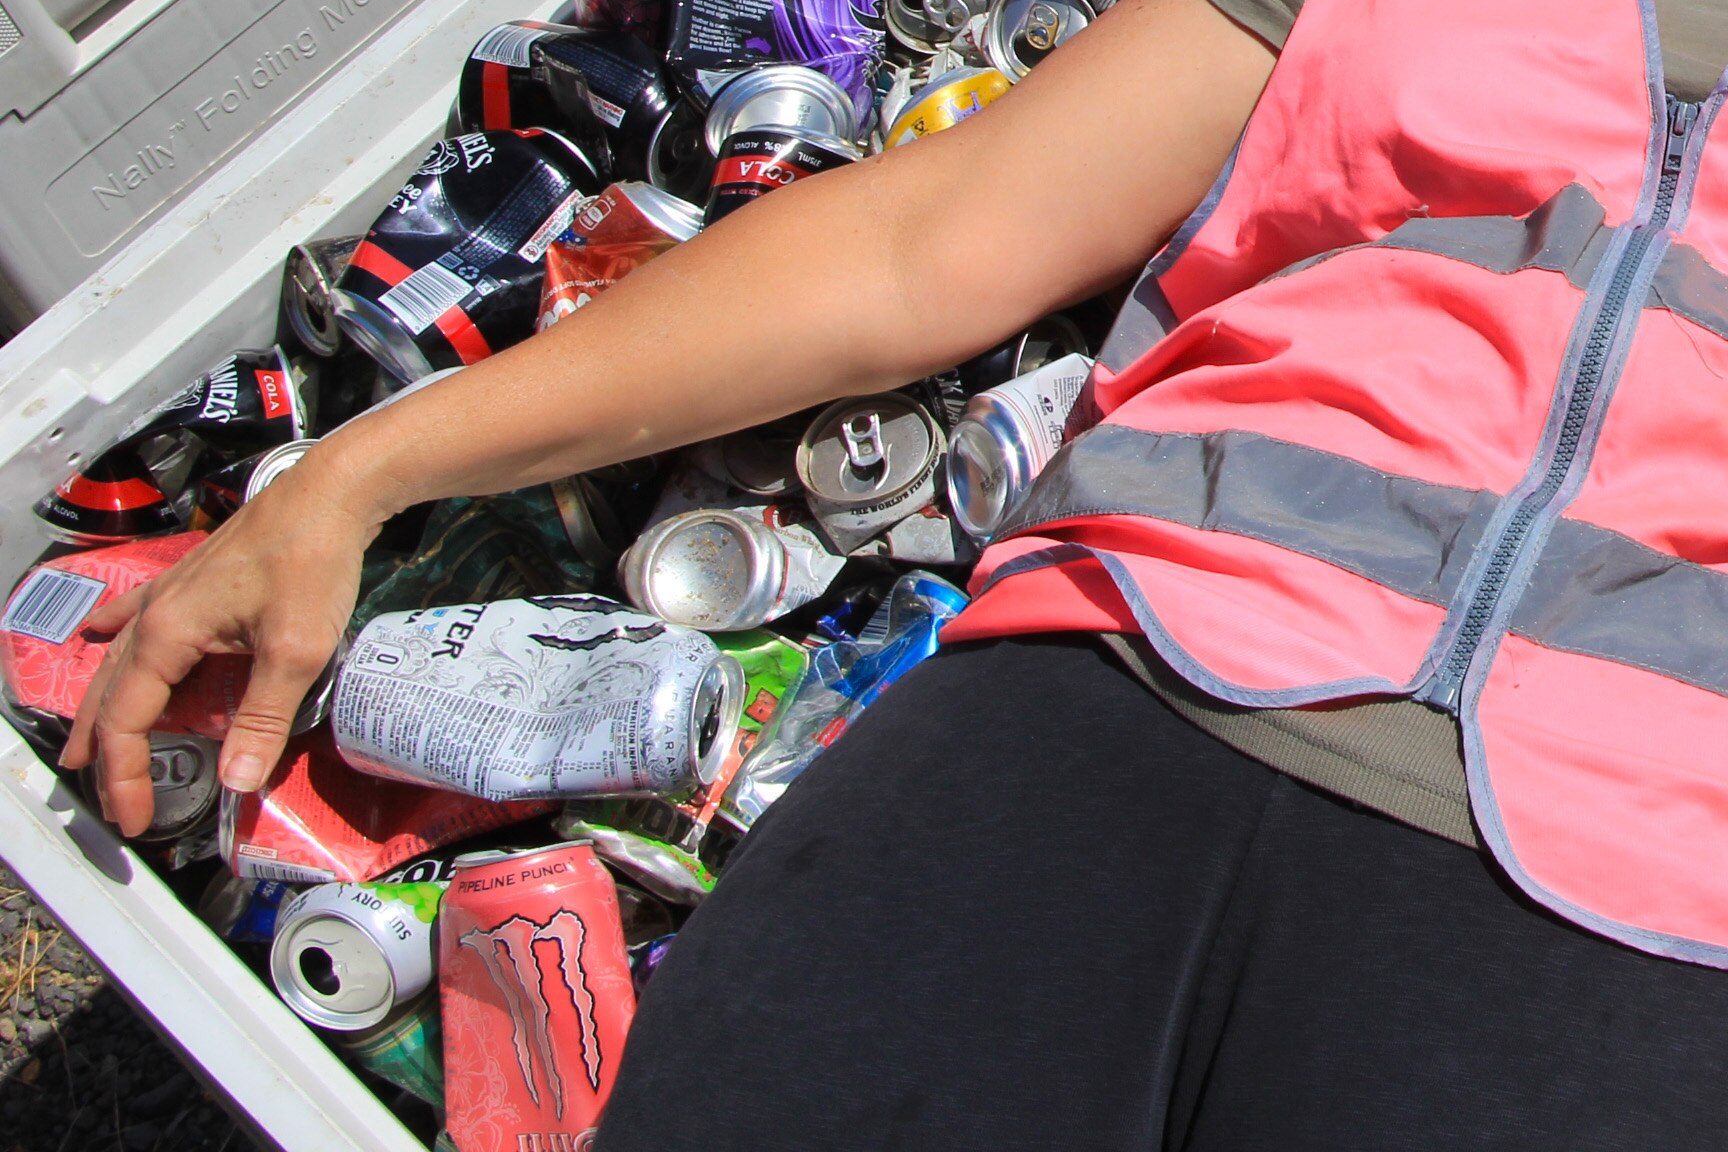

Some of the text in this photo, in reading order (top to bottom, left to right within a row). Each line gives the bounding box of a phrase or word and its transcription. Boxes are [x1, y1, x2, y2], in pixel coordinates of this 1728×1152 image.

[193, 24, 319, 134] Folding
[740, 160, 795, 185] COLA
[797, 151, 822, 167] 375mL
[262, 373, 280, 412] COLA
[850, 469, 932, 516] THE WORLD'S FINEST
[376, 653, 400, 665] 0
[628, 699, 639, 743] NUTRITION
[456, 873, 516, 894] PIPELINE
